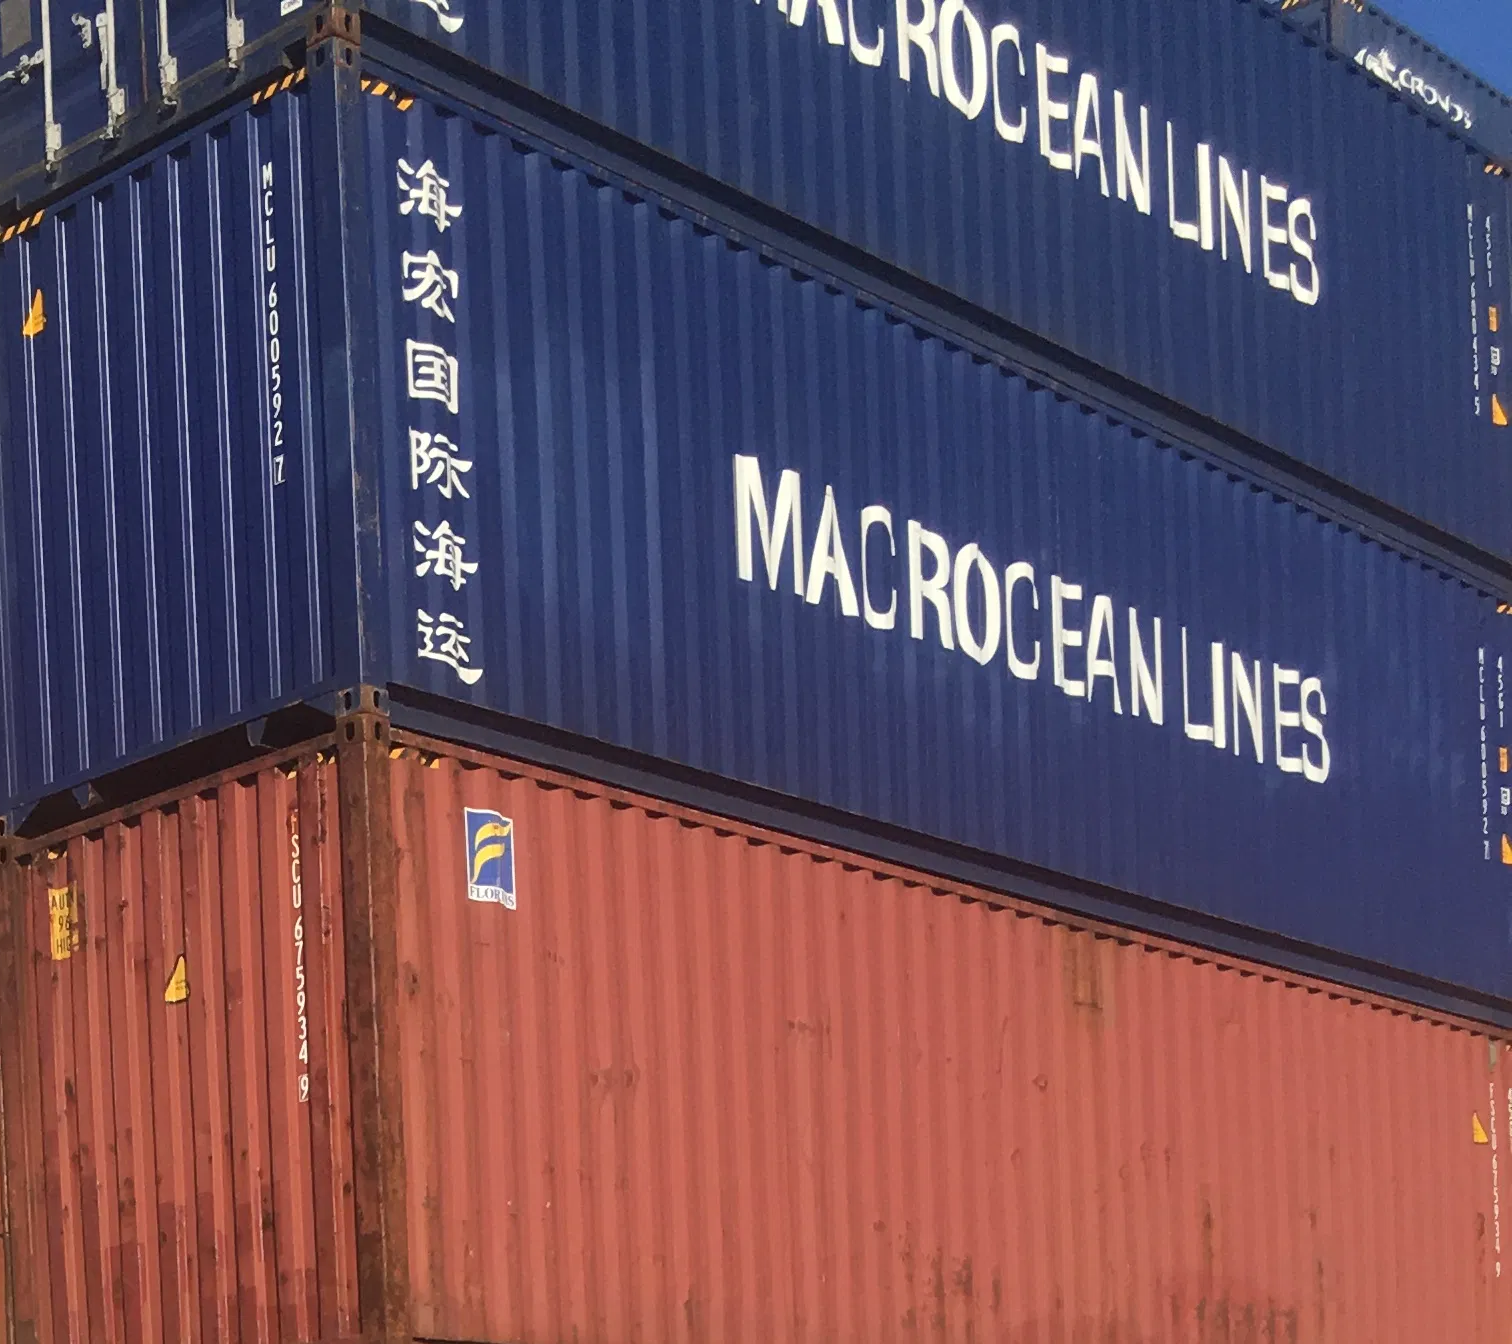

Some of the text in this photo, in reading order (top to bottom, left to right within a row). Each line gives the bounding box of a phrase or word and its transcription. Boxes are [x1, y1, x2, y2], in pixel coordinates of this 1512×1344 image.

[755, 0, 1320, 306] CROCEAN LINES
[262, 161, 285, 486] MCLU 600592 7
[395, 157, 484, 686] 海宏国际海运
[734, 453, 1331, 784] MACROCEAN LINES
[294, 916, 308, 1065] 675934
[298, 1073, 308, 1102] 9
